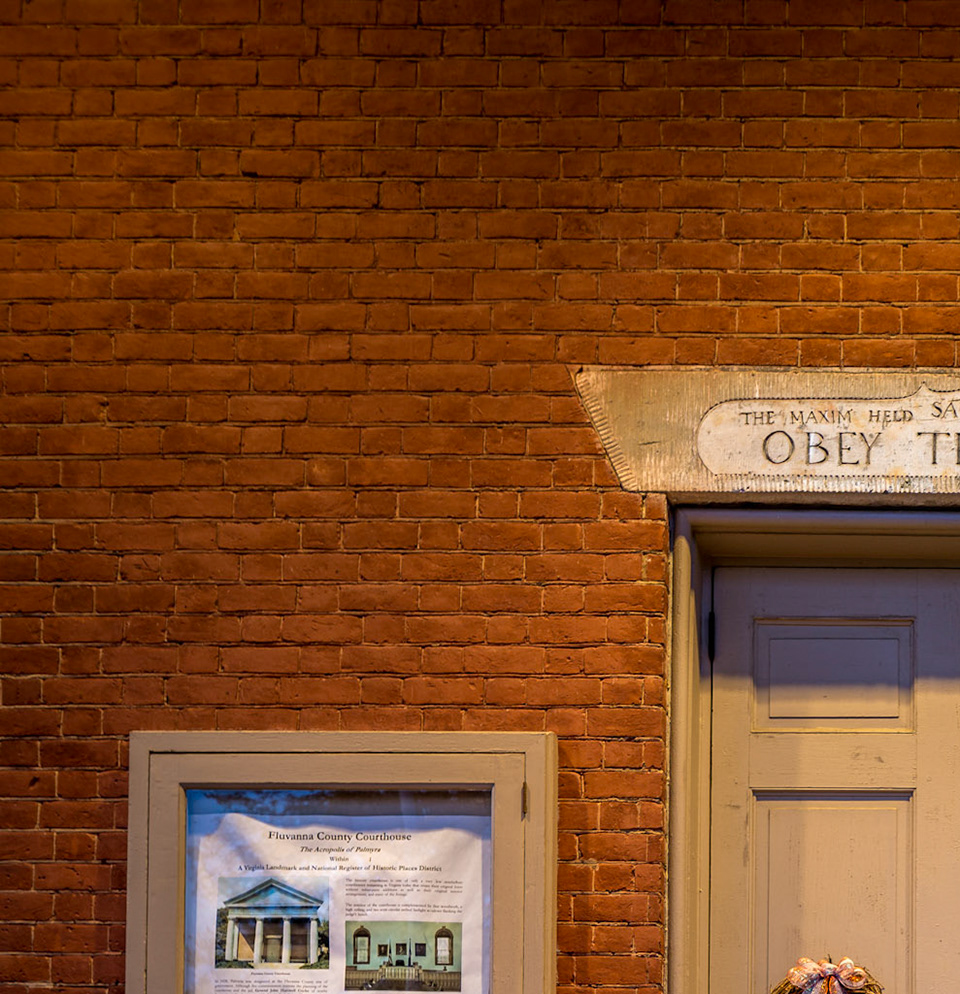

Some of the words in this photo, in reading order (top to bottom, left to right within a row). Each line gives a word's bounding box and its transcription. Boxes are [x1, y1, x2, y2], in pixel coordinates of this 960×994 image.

[740, 411, 775, 425] THE
[789, 409, 853, 425] MAXIM
[868, 410, 914, 424] HELD
[763, 430, 882, 465] OBEY
[268, 831, 314, 841] Fluvanna
[316, 831, 352, 843] County
[355, 831, 412, 841] Courthouse
[314, 846, 345, 854] Acropolis
[355, 846, 382, 854] Palmyra
